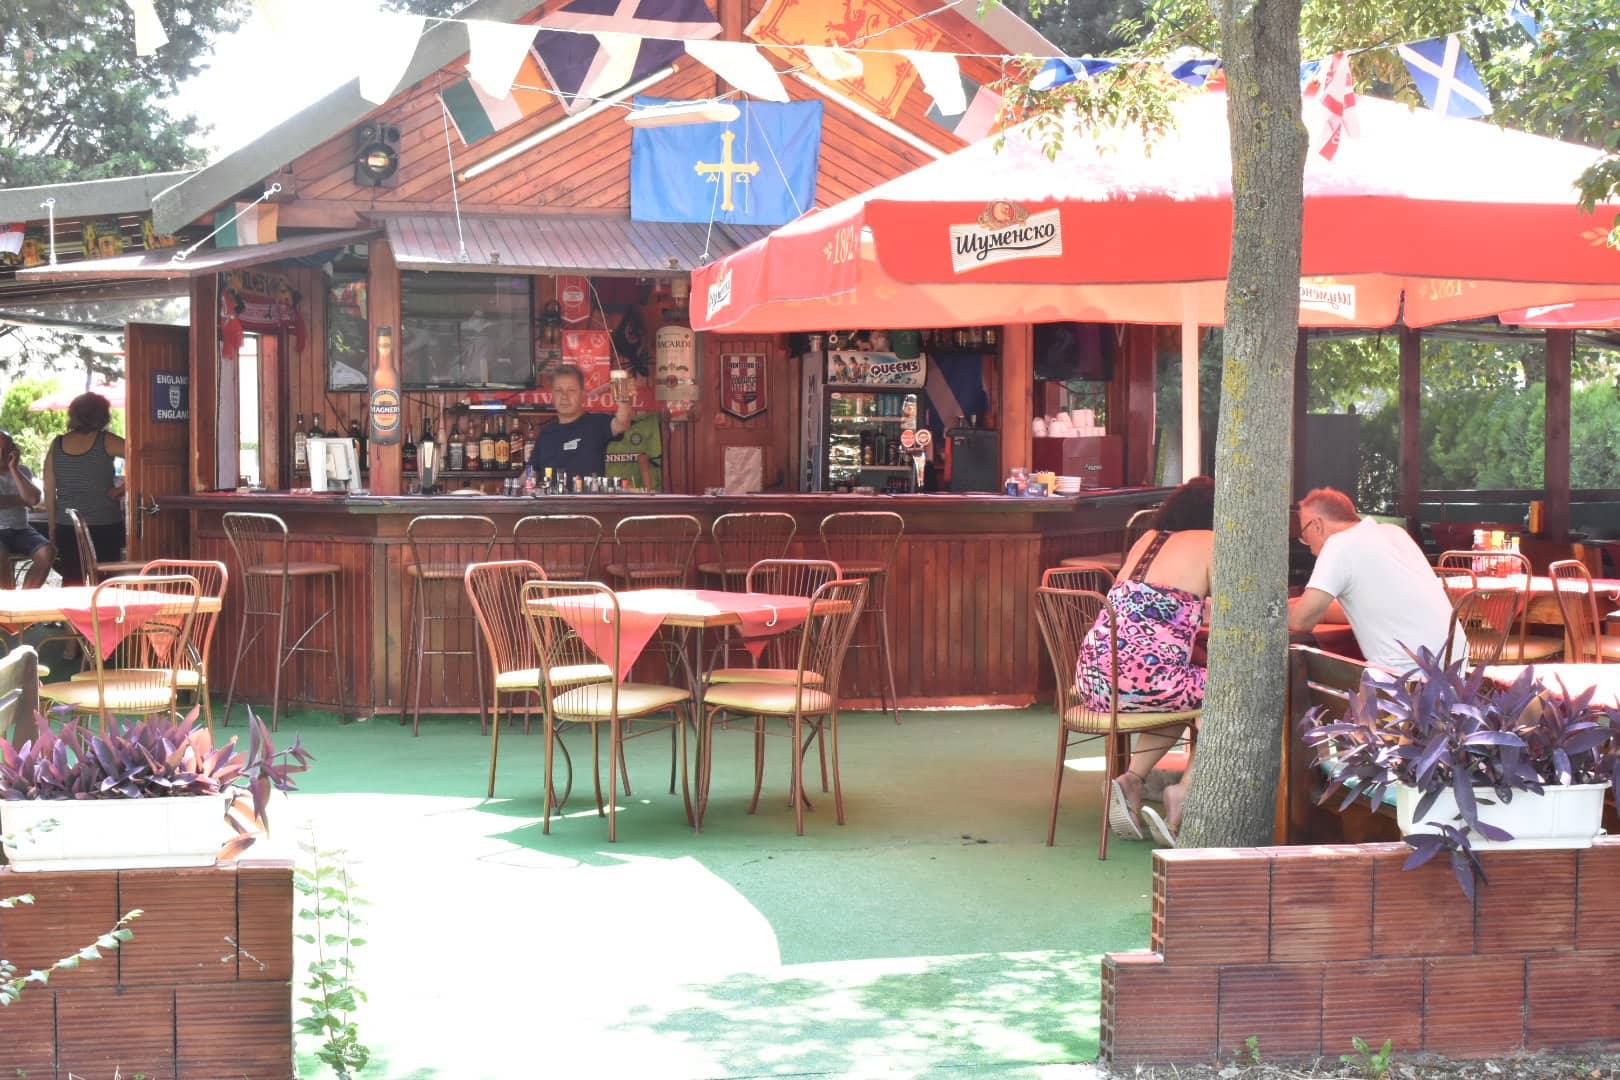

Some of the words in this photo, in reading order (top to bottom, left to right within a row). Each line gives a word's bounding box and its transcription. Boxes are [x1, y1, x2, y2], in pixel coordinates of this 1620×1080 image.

[956, 223, 1057, 261] Шуменско
[870, 360, 919, 377] QUEEN'S
[518, 391, 645, 409] LIVPOL
